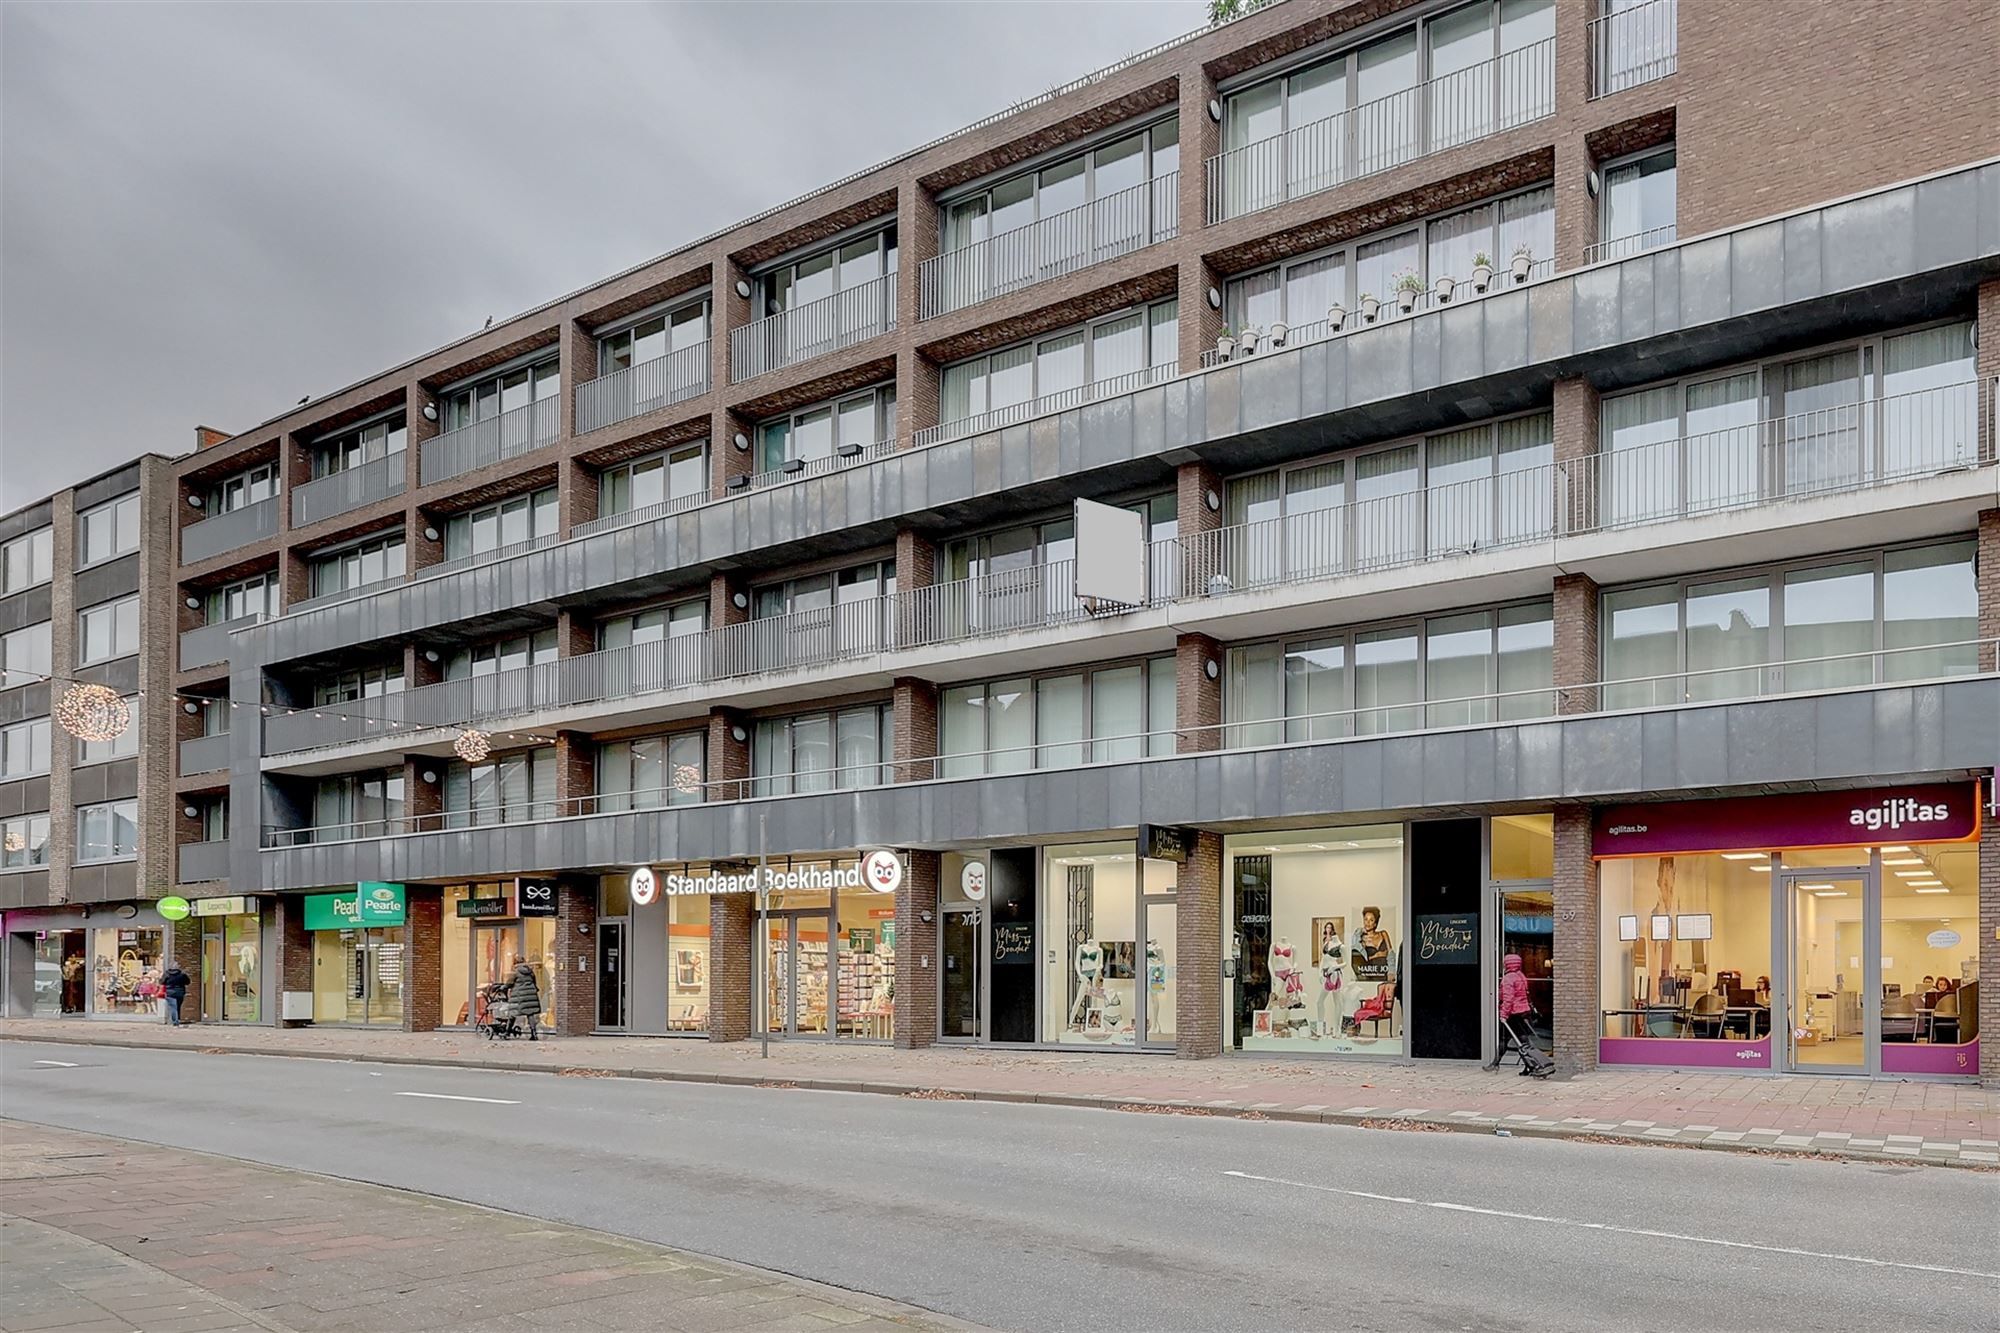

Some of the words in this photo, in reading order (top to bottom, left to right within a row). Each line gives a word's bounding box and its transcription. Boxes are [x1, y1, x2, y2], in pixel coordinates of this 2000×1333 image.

[1849, 798, 1949, 830] agilitas
[1608, 824, 1648, 836] agilitas.be
[665, 864, 758, 896] Standaard
[764, 863, 866, 891] Boekhand
[365, 899, 402, 911] Pearle
[1562, 911, 1576, 921] 69
[1420, 920, 1458, 940] Miss
[1357, 964, 1378, 973] MARIE
[1735, 1049, 1762, 1059] agilitas
